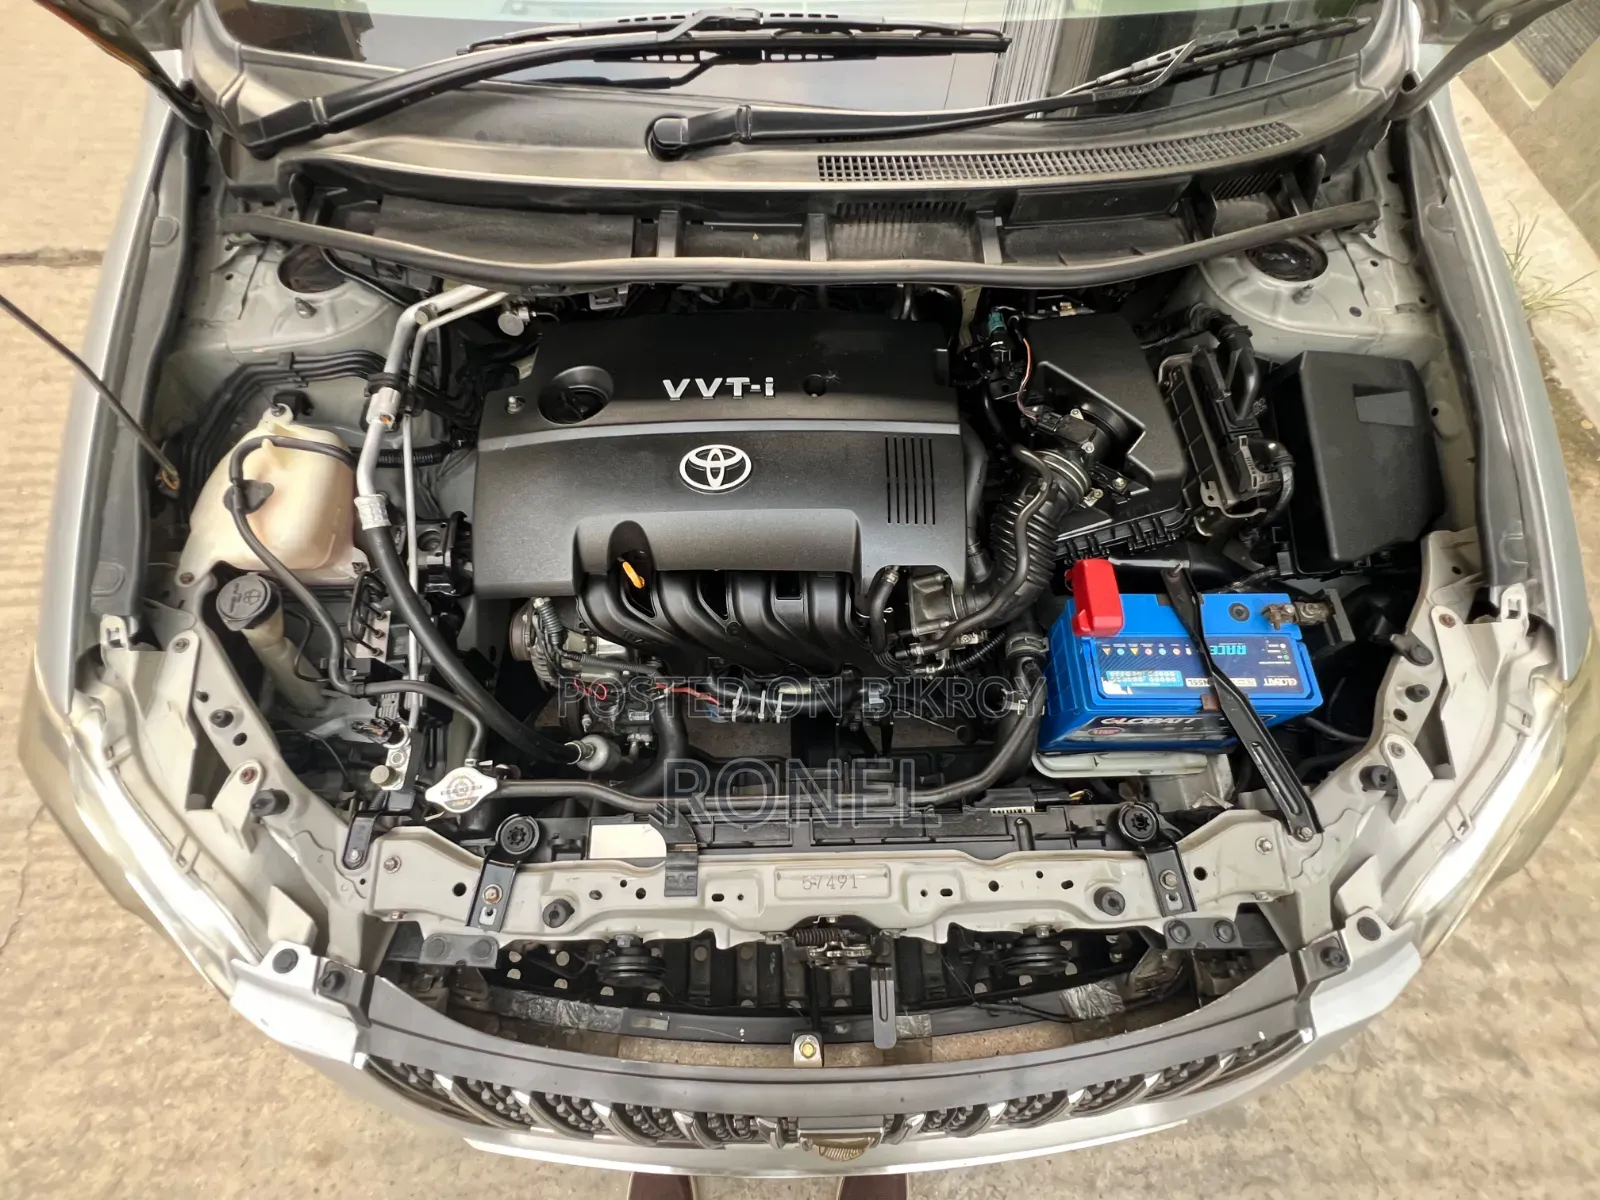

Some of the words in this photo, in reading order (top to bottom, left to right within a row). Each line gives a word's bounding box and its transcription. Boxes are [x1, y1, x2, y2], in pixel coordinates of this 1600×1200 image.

[662, 376, 775, 400] VVT-i
[1209, 645, 1247, 656] RACE
[1100, 717, 1199, 725] GLOBATT
